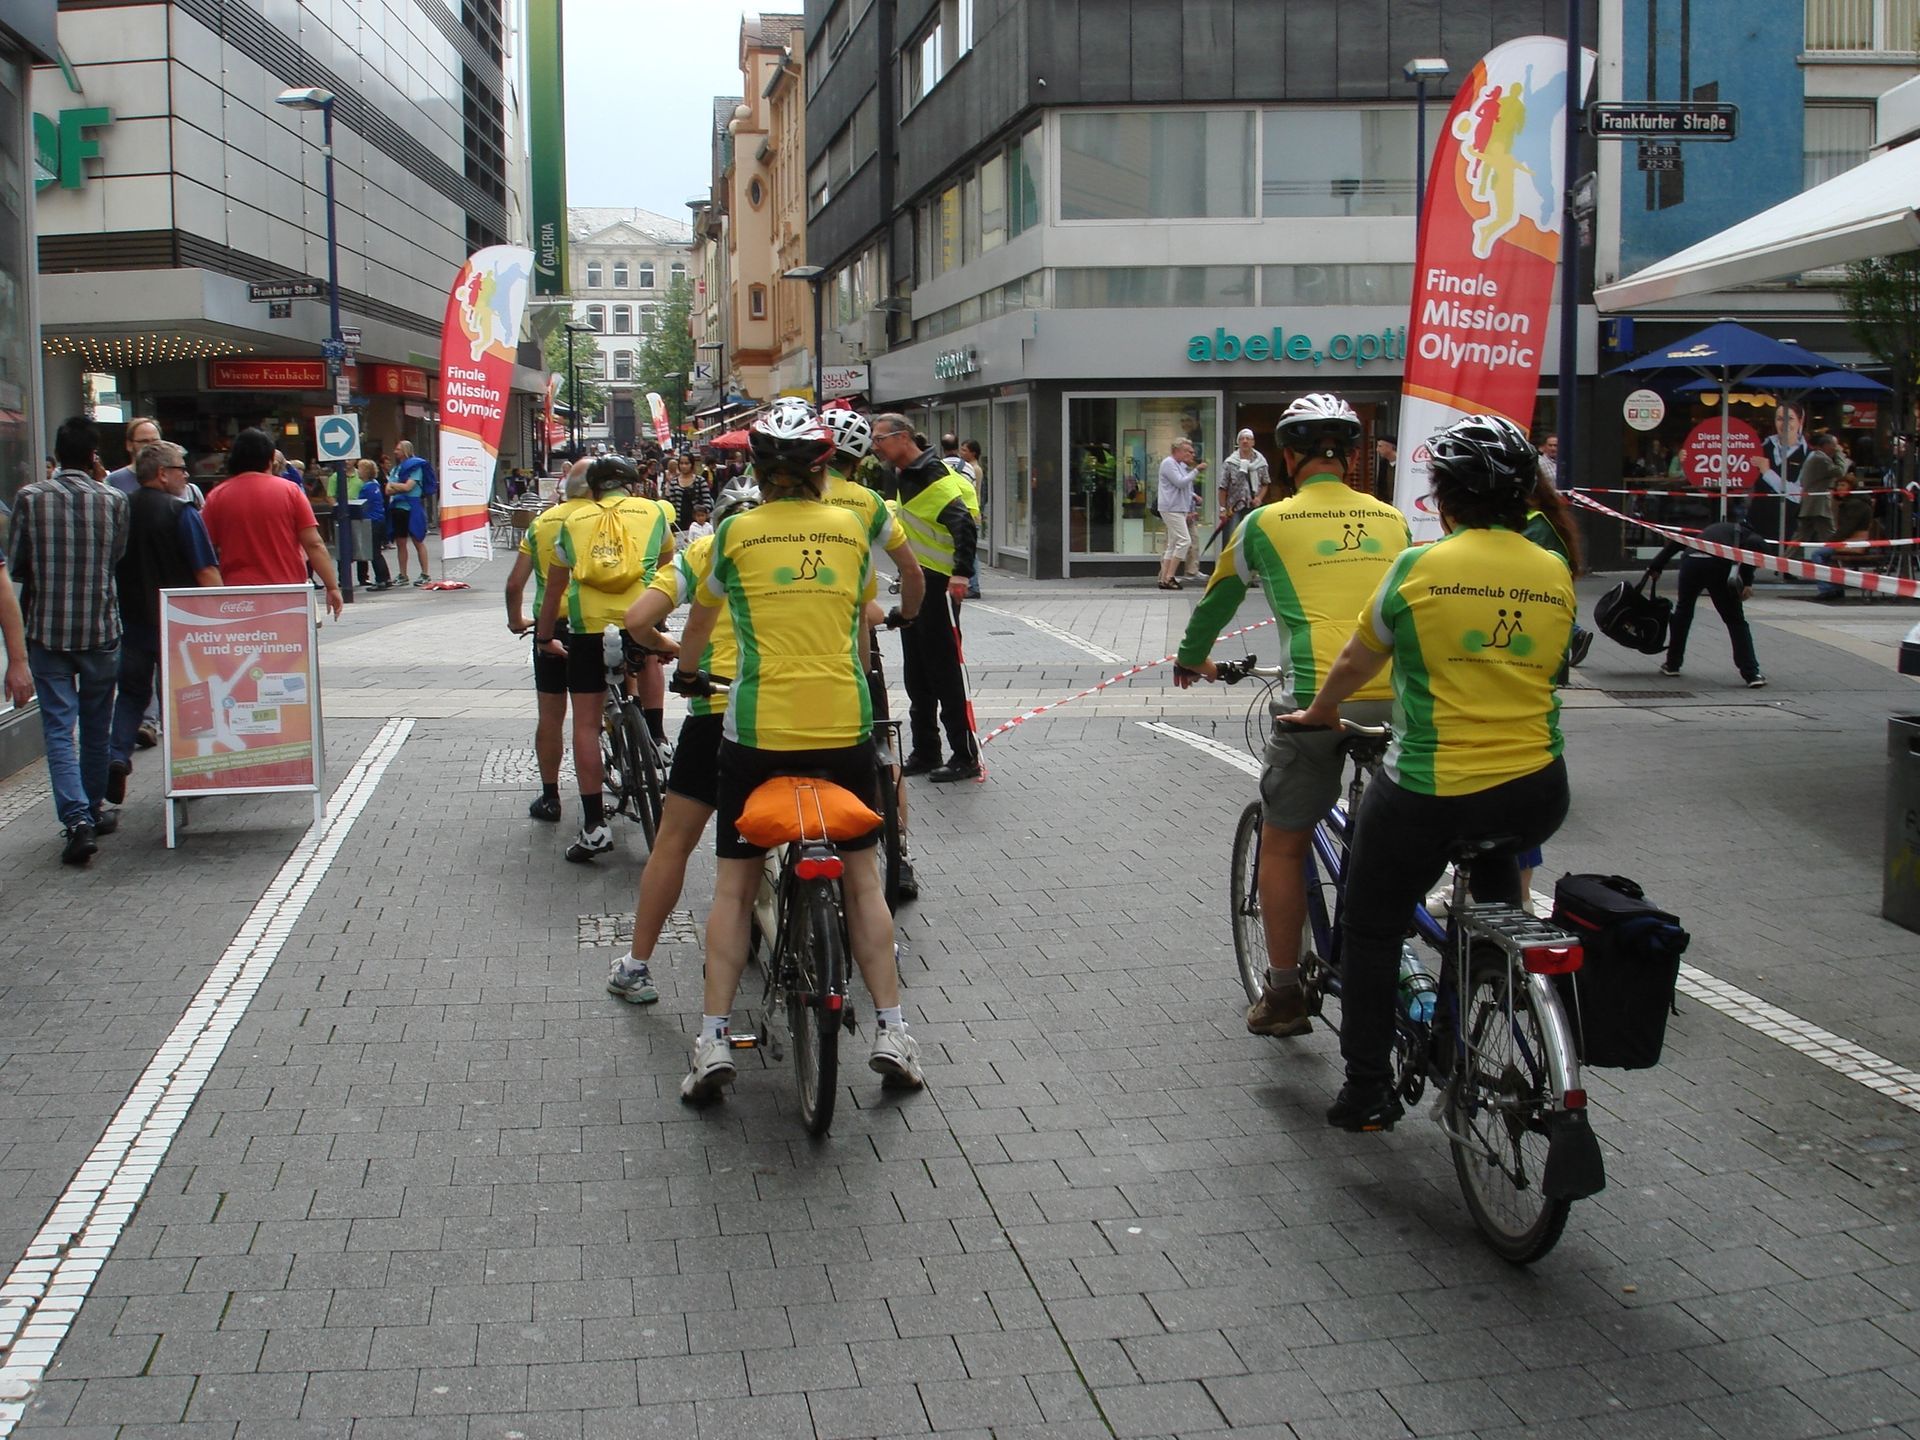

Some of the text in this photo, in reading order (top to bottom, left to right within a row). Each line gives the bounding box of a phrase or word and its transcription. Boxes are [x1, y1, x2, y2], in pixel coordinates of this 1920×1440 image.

[1601, 113, 1727, 132] Frankfurter Straße
[1646, 147, 1673, 155] 25-31
[541, 222, 556, 267] GALERIA
[1426, 268, 1498, 297] Finale
[252, 286, 293, 297] Frankfurter
[1422, 299, 1530, 335] Mission
[1418, 333, 1534, 372] Olympic
[220, 367, 321, 380] Wiener Feinbäcker
[447, 365, 486, 382] Finale
[446, 381, 500, 402] Mission
[446, 398, 502, 420] Olympic
[1697, 432, 1750, 441] Diese oche
[1691, 441, 1706, 449] auf
[1694, 454, 1751, 473] 20%
[831, 497, 867, 508] Offenbach
[1278, 510, 1346, 522] Tandemclub
[1349, 509, 1399, 522] Offenbach
[741, 533, 858, 549] Tandemclub Offenbach
[1428, 583, 1505, 598] Tandemclub
[184, 630, 278, 643] Aktiv werden
[203, 641, 303, 656] und gewinnen
